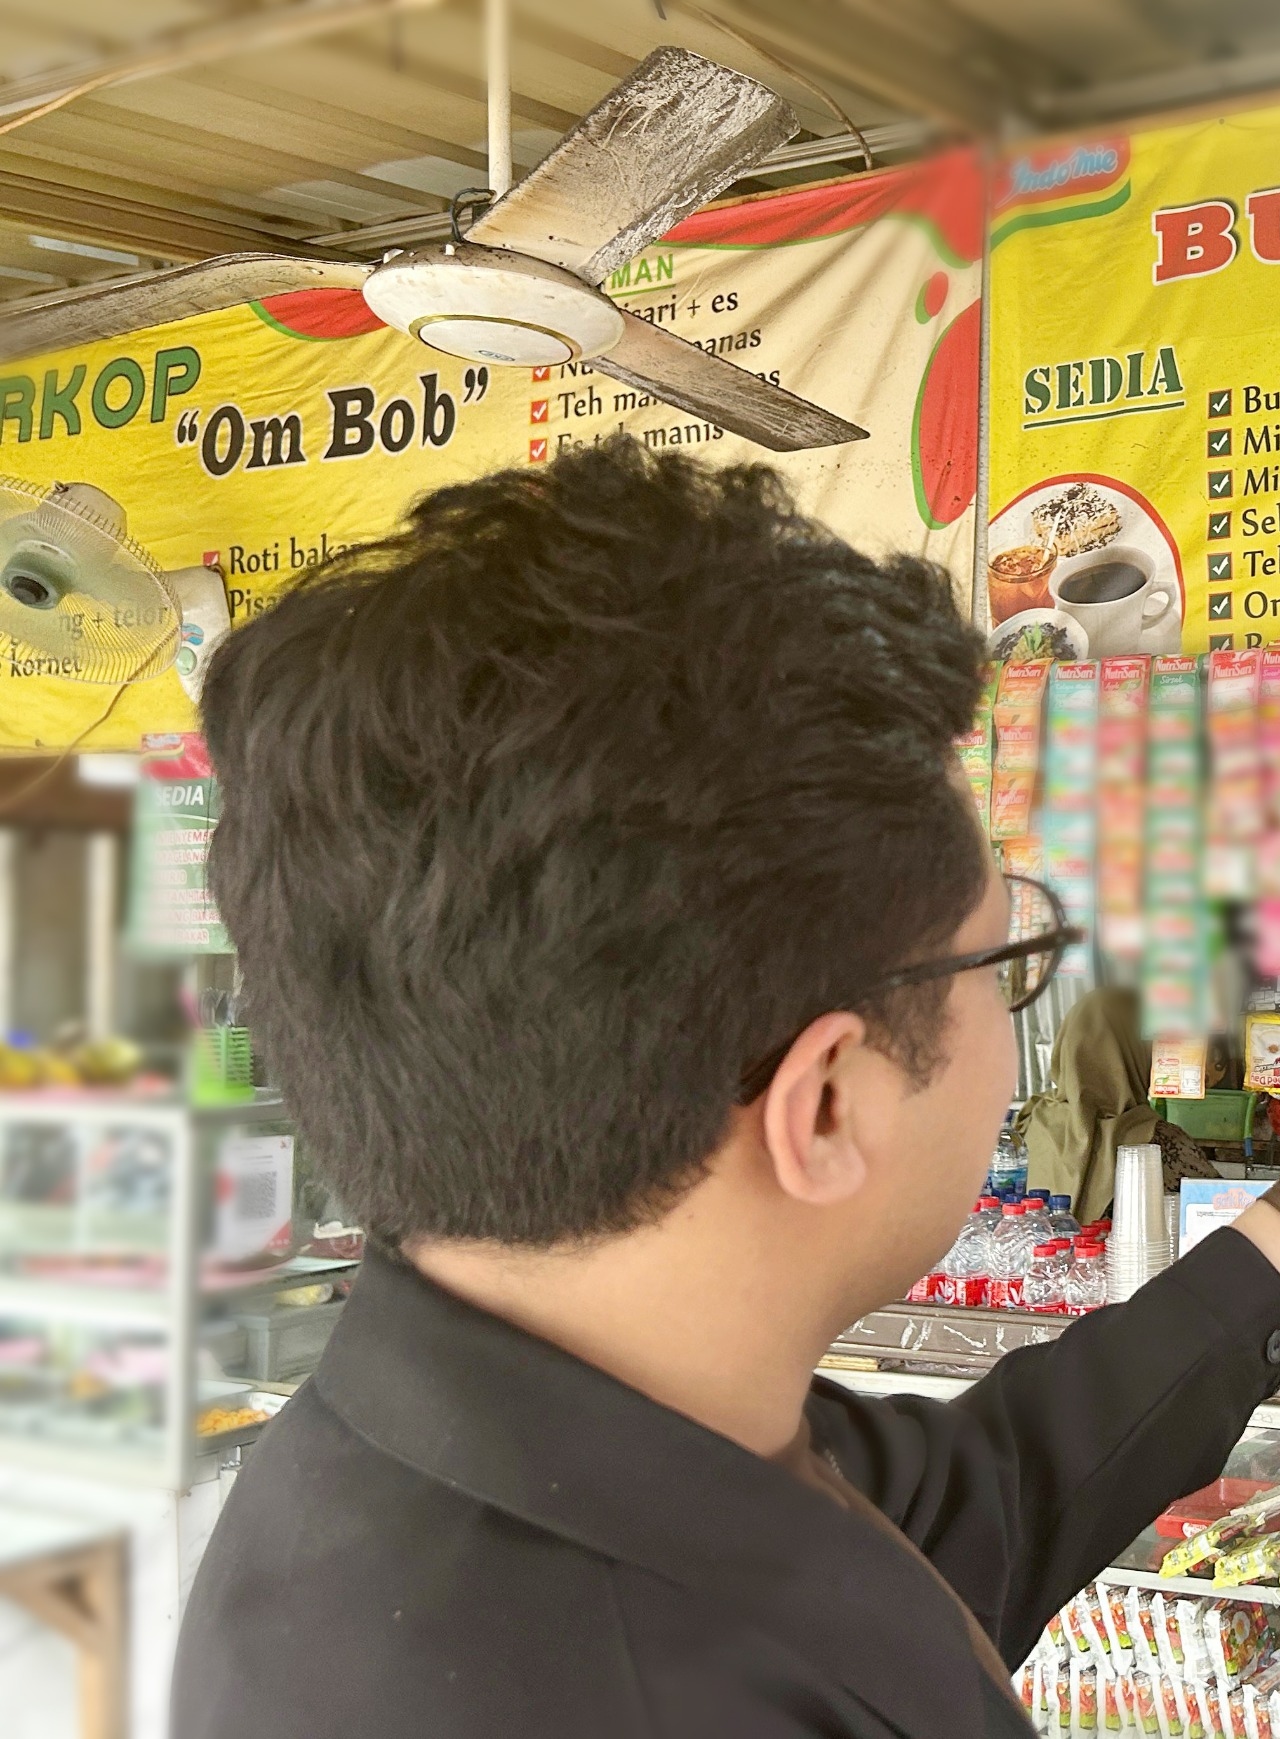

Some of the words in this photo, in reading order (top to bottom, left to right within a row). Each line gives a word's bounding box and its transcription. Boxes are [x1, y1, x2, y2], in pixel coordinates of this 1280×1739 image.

[711, 291, 738, 313] es
[1024, 347, 1184, 415] SEDIA
[558, 386, 602, 419] Teh
[177, 405, 306, 476] “Om
[324, 366, 488, 459] Bob”
[229, 542, 279, 574] Roti
